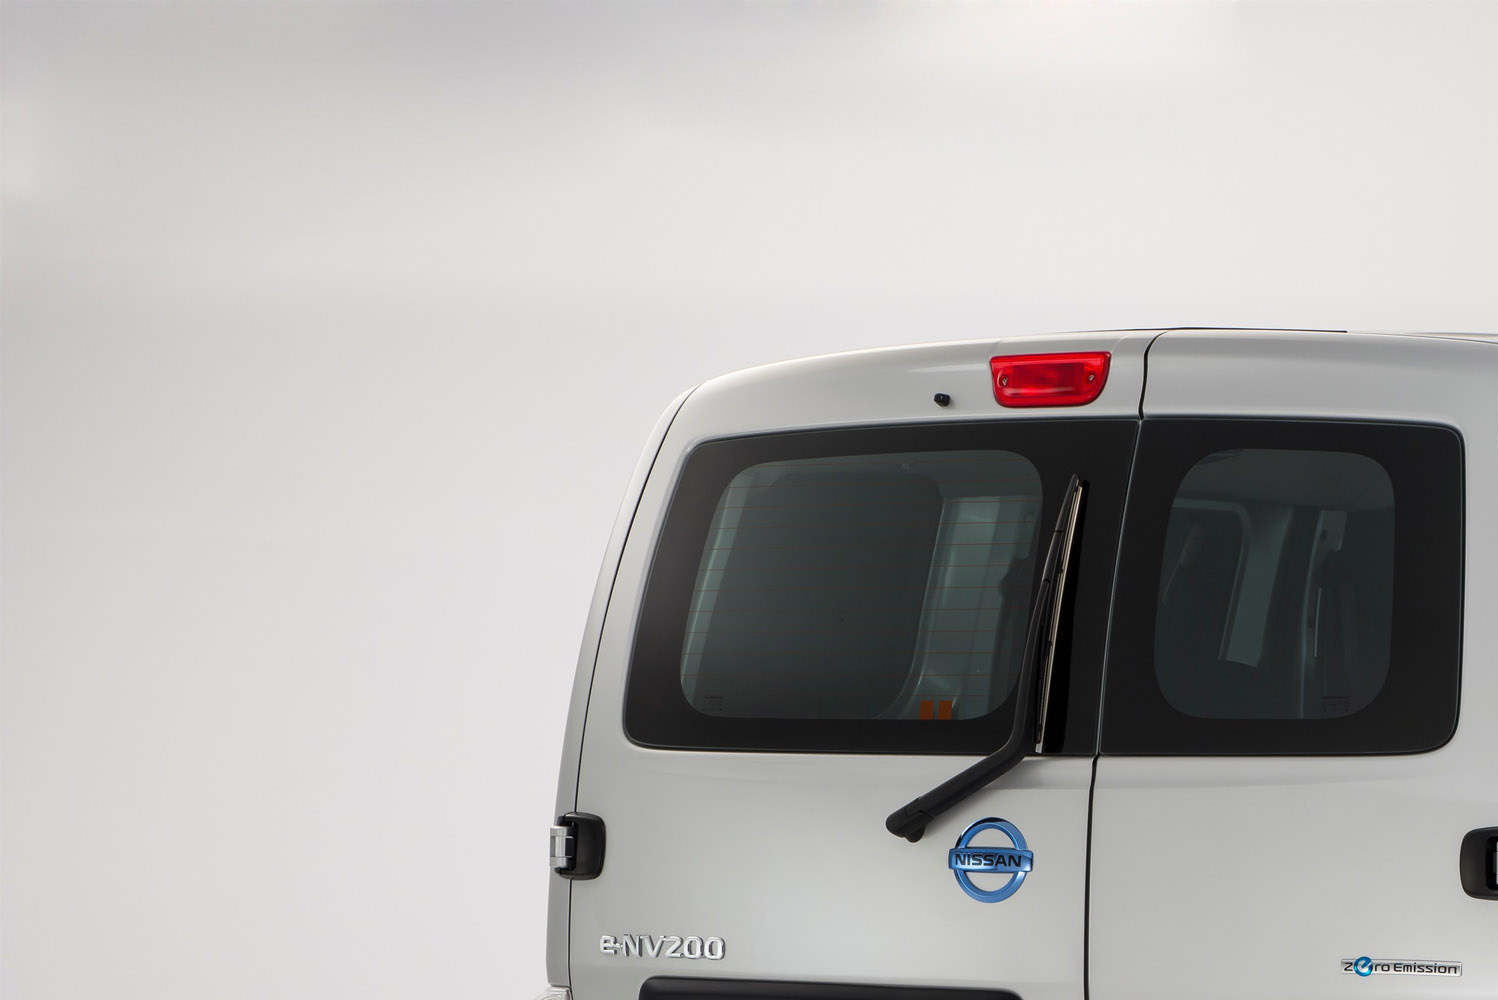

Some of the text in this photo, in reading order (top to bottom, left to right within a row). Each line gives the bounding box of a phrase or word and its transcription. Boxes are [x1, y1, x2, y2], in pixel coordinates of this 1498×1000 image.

[955, 853, 1021, 867] NISSAN
[600, 933, 725, 960] e-NV200
[1394, 962, 1457, 974] Emission
